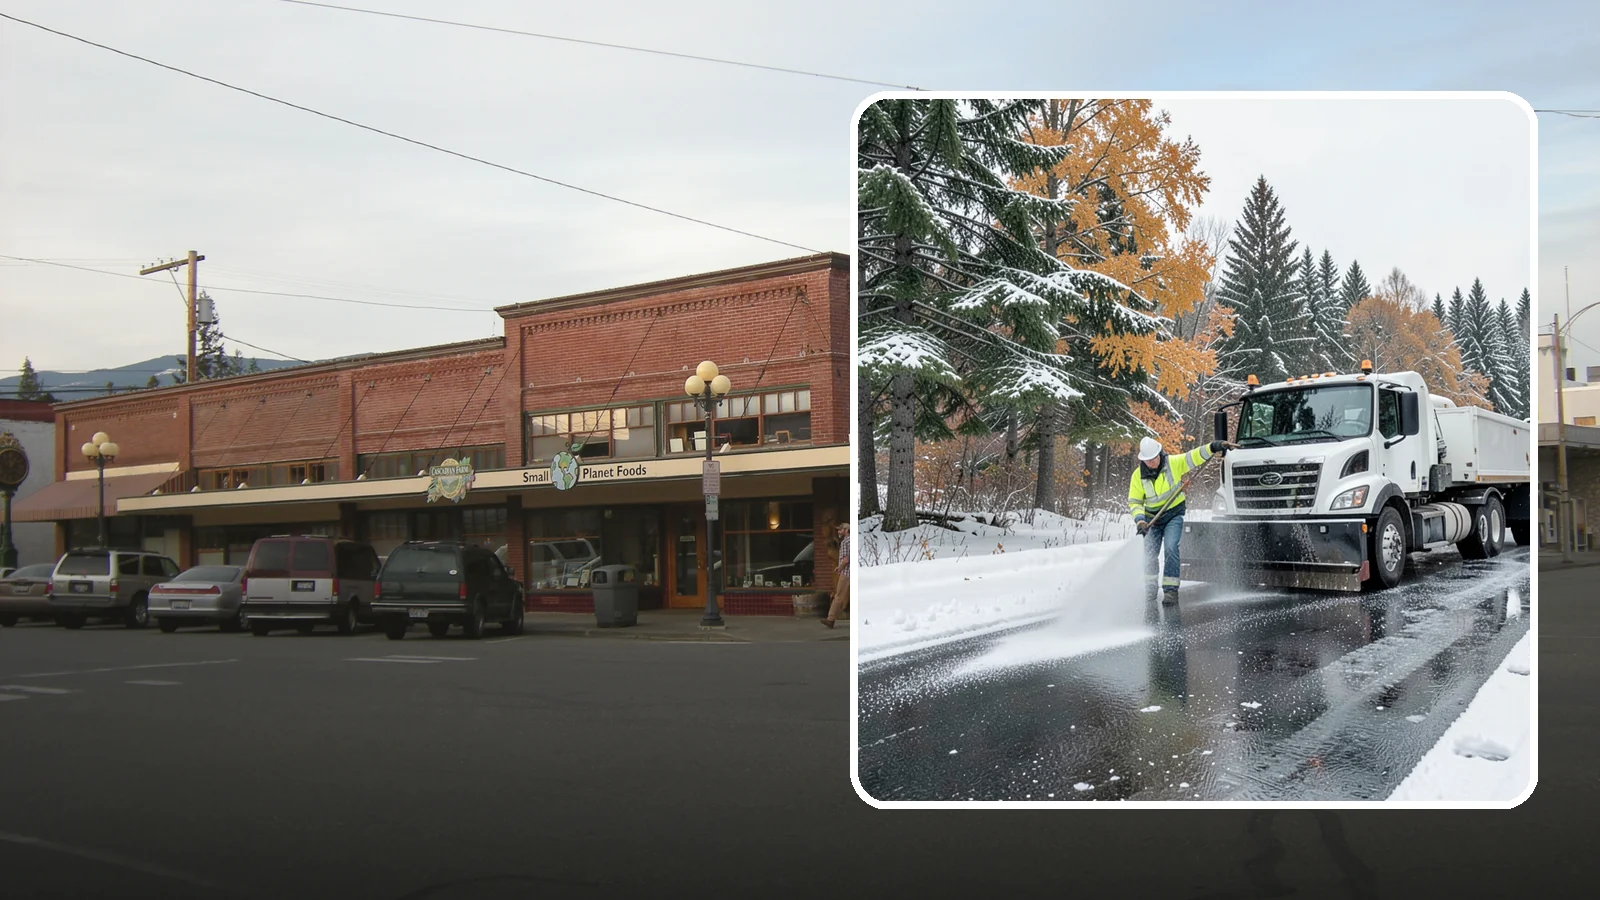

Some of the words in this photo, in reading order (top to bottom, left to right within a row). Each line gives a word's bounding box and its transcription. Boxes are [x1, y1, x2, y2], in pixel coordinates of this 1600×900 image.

[523, 471, 548, 483] Small
[583, 467, 614, 479] Planet
[617, 464, 647, 477] Foods
